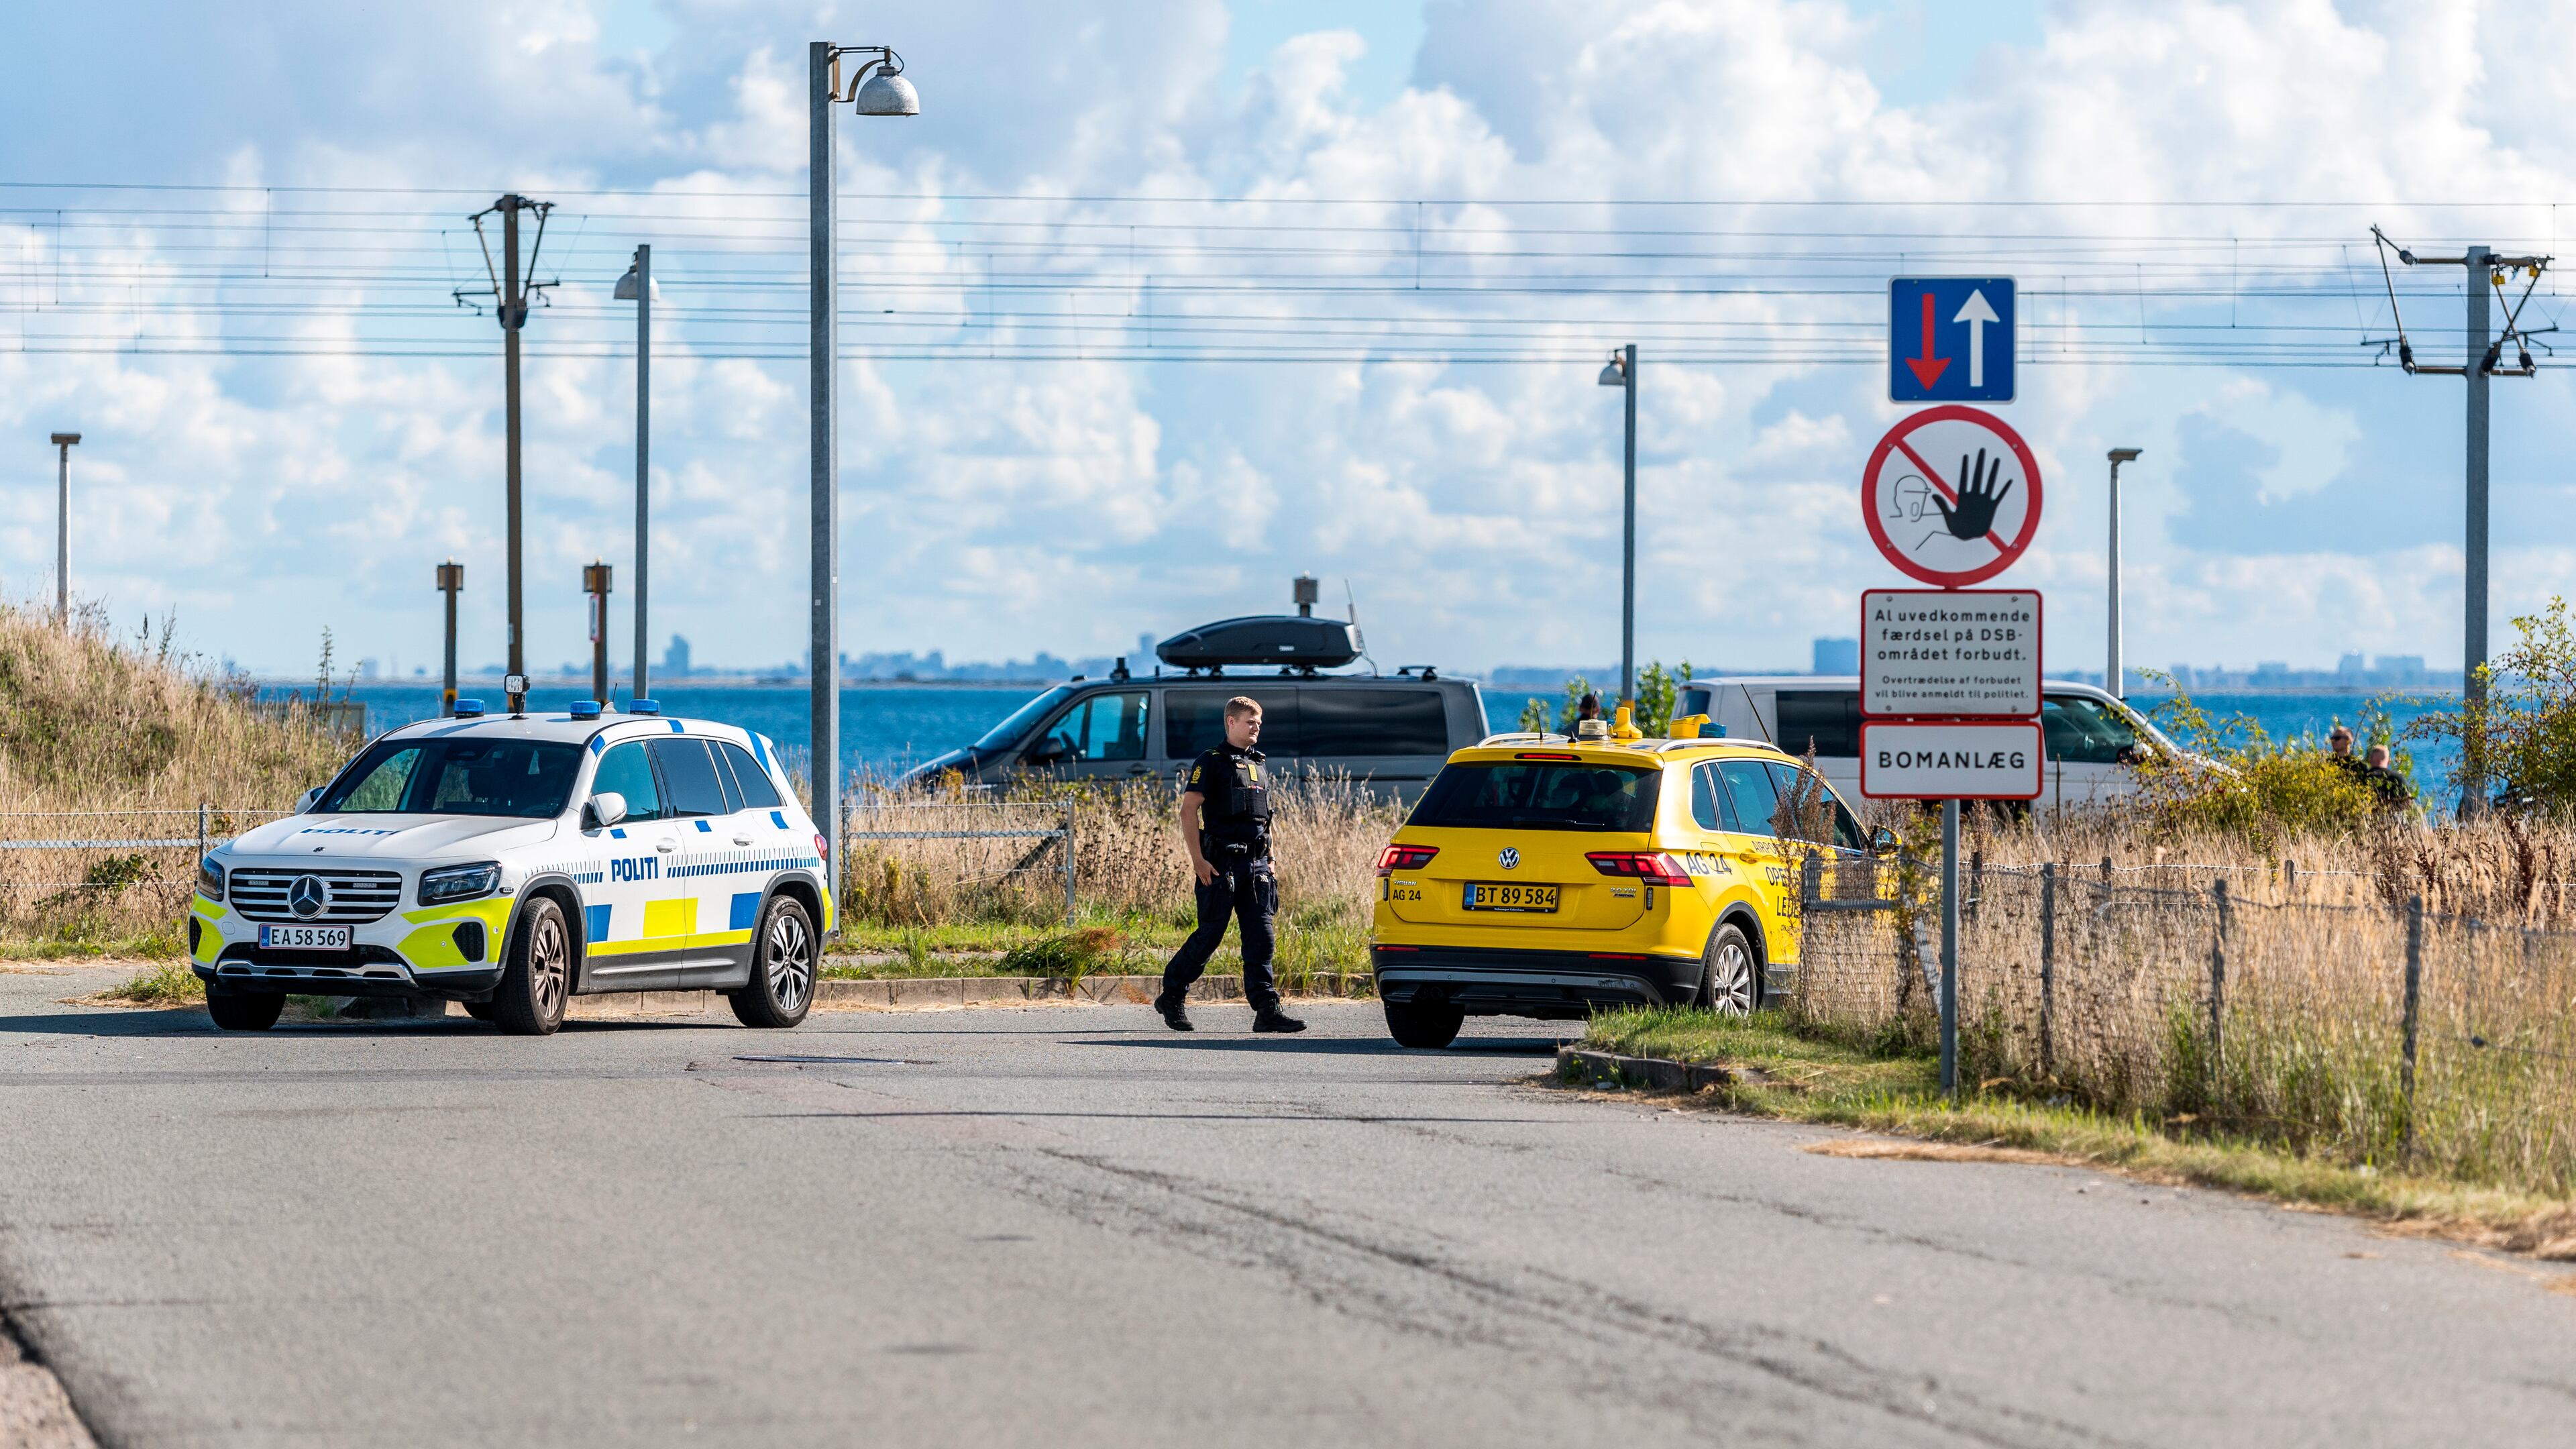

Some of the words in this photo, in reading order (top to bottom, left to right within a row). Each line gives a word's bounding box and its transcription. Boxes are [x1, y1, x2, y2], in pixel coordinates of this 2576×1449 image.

[1875, 609, 1892, 621] Al
[1898, 610, 2030, 622] uvedkommende
[1882, 629, 1948, 641] færdsel
[1954, 629, 1974, 643] på
[1981, 629, 2023, 641] DSB-
[1878, 648, 1948, 660] området
[1955, 648, 2027, 661] forbudt.
[1882, 676, 1955, 685] Overtrædelse
[1960, 676, 1970, 685] af
[1974, 676, 2021, 685] forbudet
[1875, 690, 1888, 698] vil
[1892, 690, 1918, 698] blive
[1921, 690, 1965, 698] anmeldt
[1968, 690, 1981, 698] til
[1984, 690, 2029, 700] politiet.
[1879, 751, 2025, 769] BOMANLÆG
[611, 857, 659, 882] POLITI
[1686, 852, 1710, 875] AG
[1709, 853, 1733, 875] 24
[1393, 890, 1405, 900] AG
[1409, 890, 1421, 900] 24
[1476, 887, 1498, 904] BT
[1501, 888, 1521, 904] 89
[1525, 888, 1555, 905] 584
[272, 928, 291, 945] EA
[295, 929, 313, 946] 58
[317, 930, 346, 947] 569
